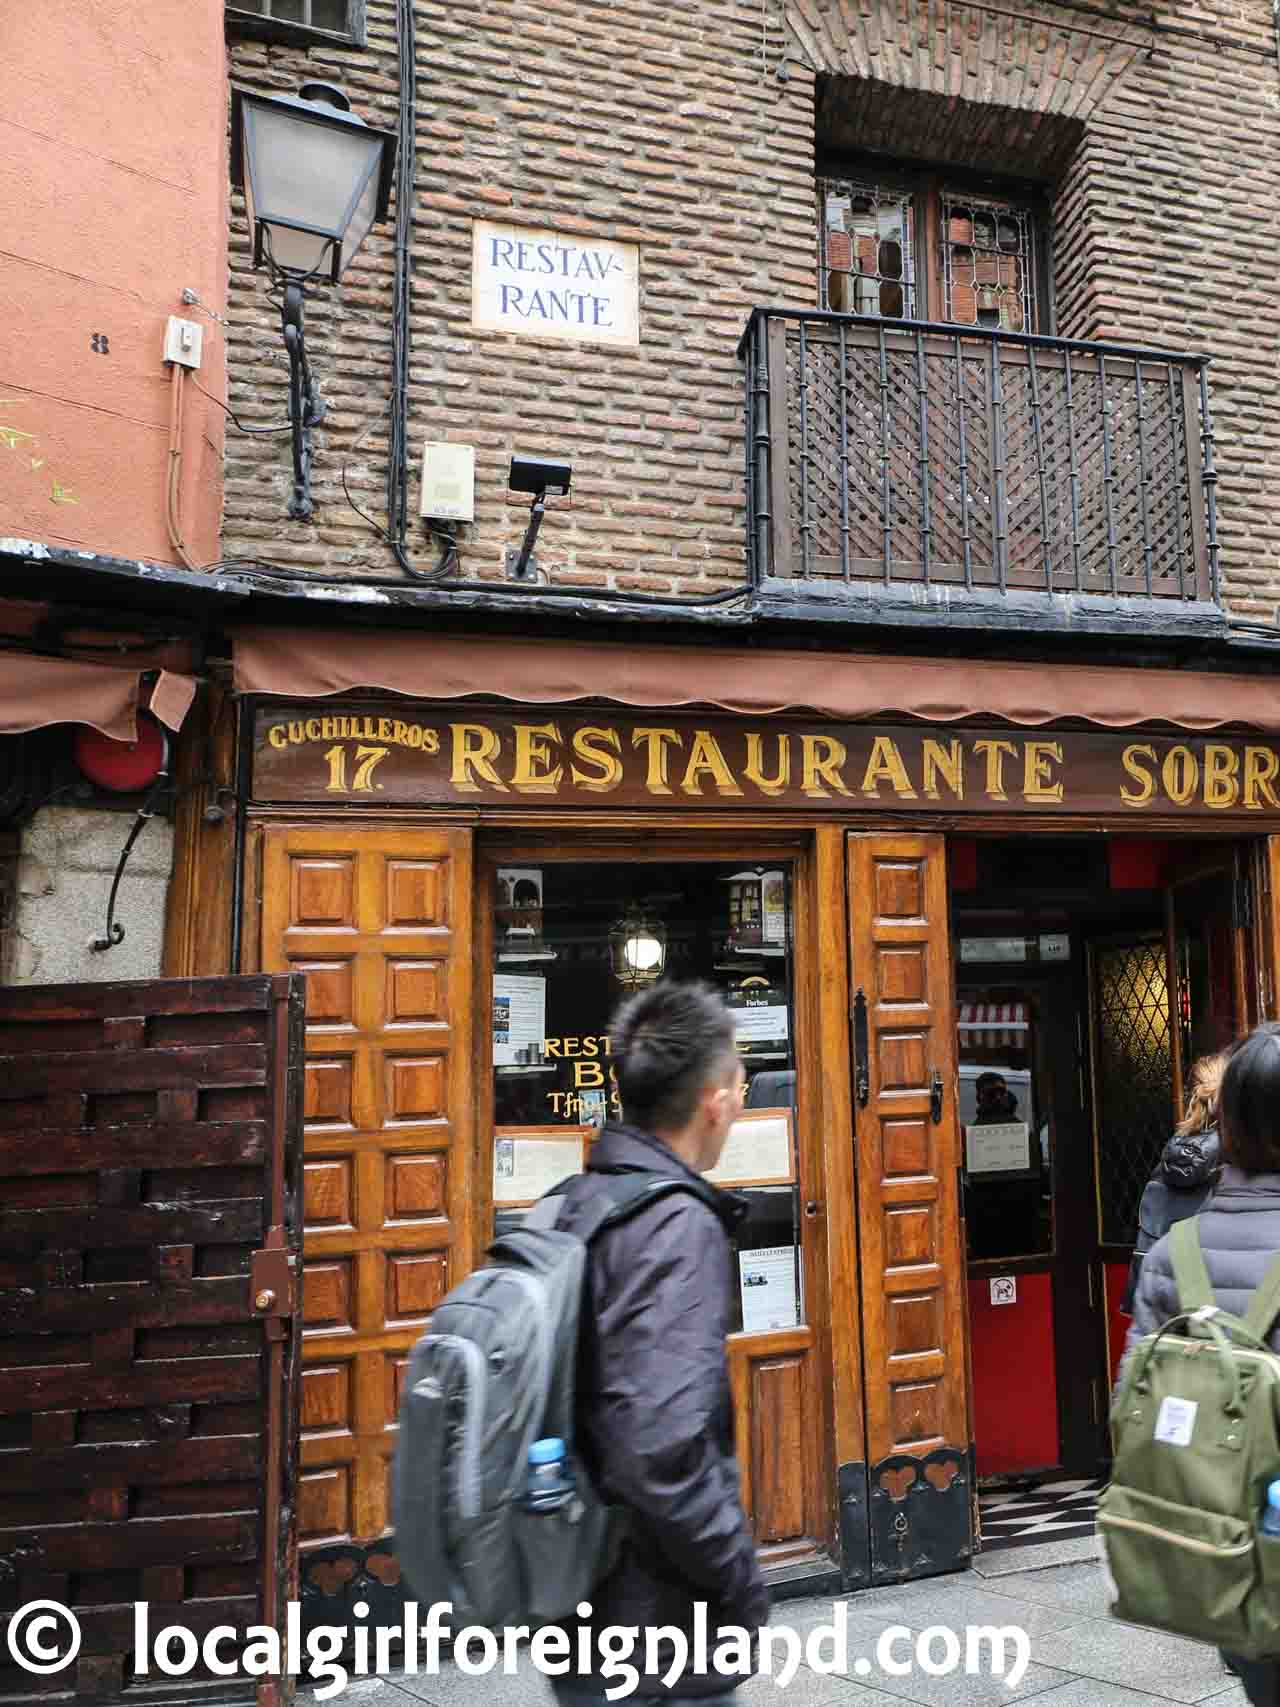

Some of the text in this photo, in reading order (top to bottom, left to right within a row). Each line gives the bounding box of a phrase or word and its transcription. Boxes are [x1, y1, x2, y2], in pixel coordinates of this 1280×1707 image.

[497, 283, 615, 327] RANTE
[268, 715, 441, 753] CUCHILLEROS
[448, 722, 1065, 803] RESTAURANTE
